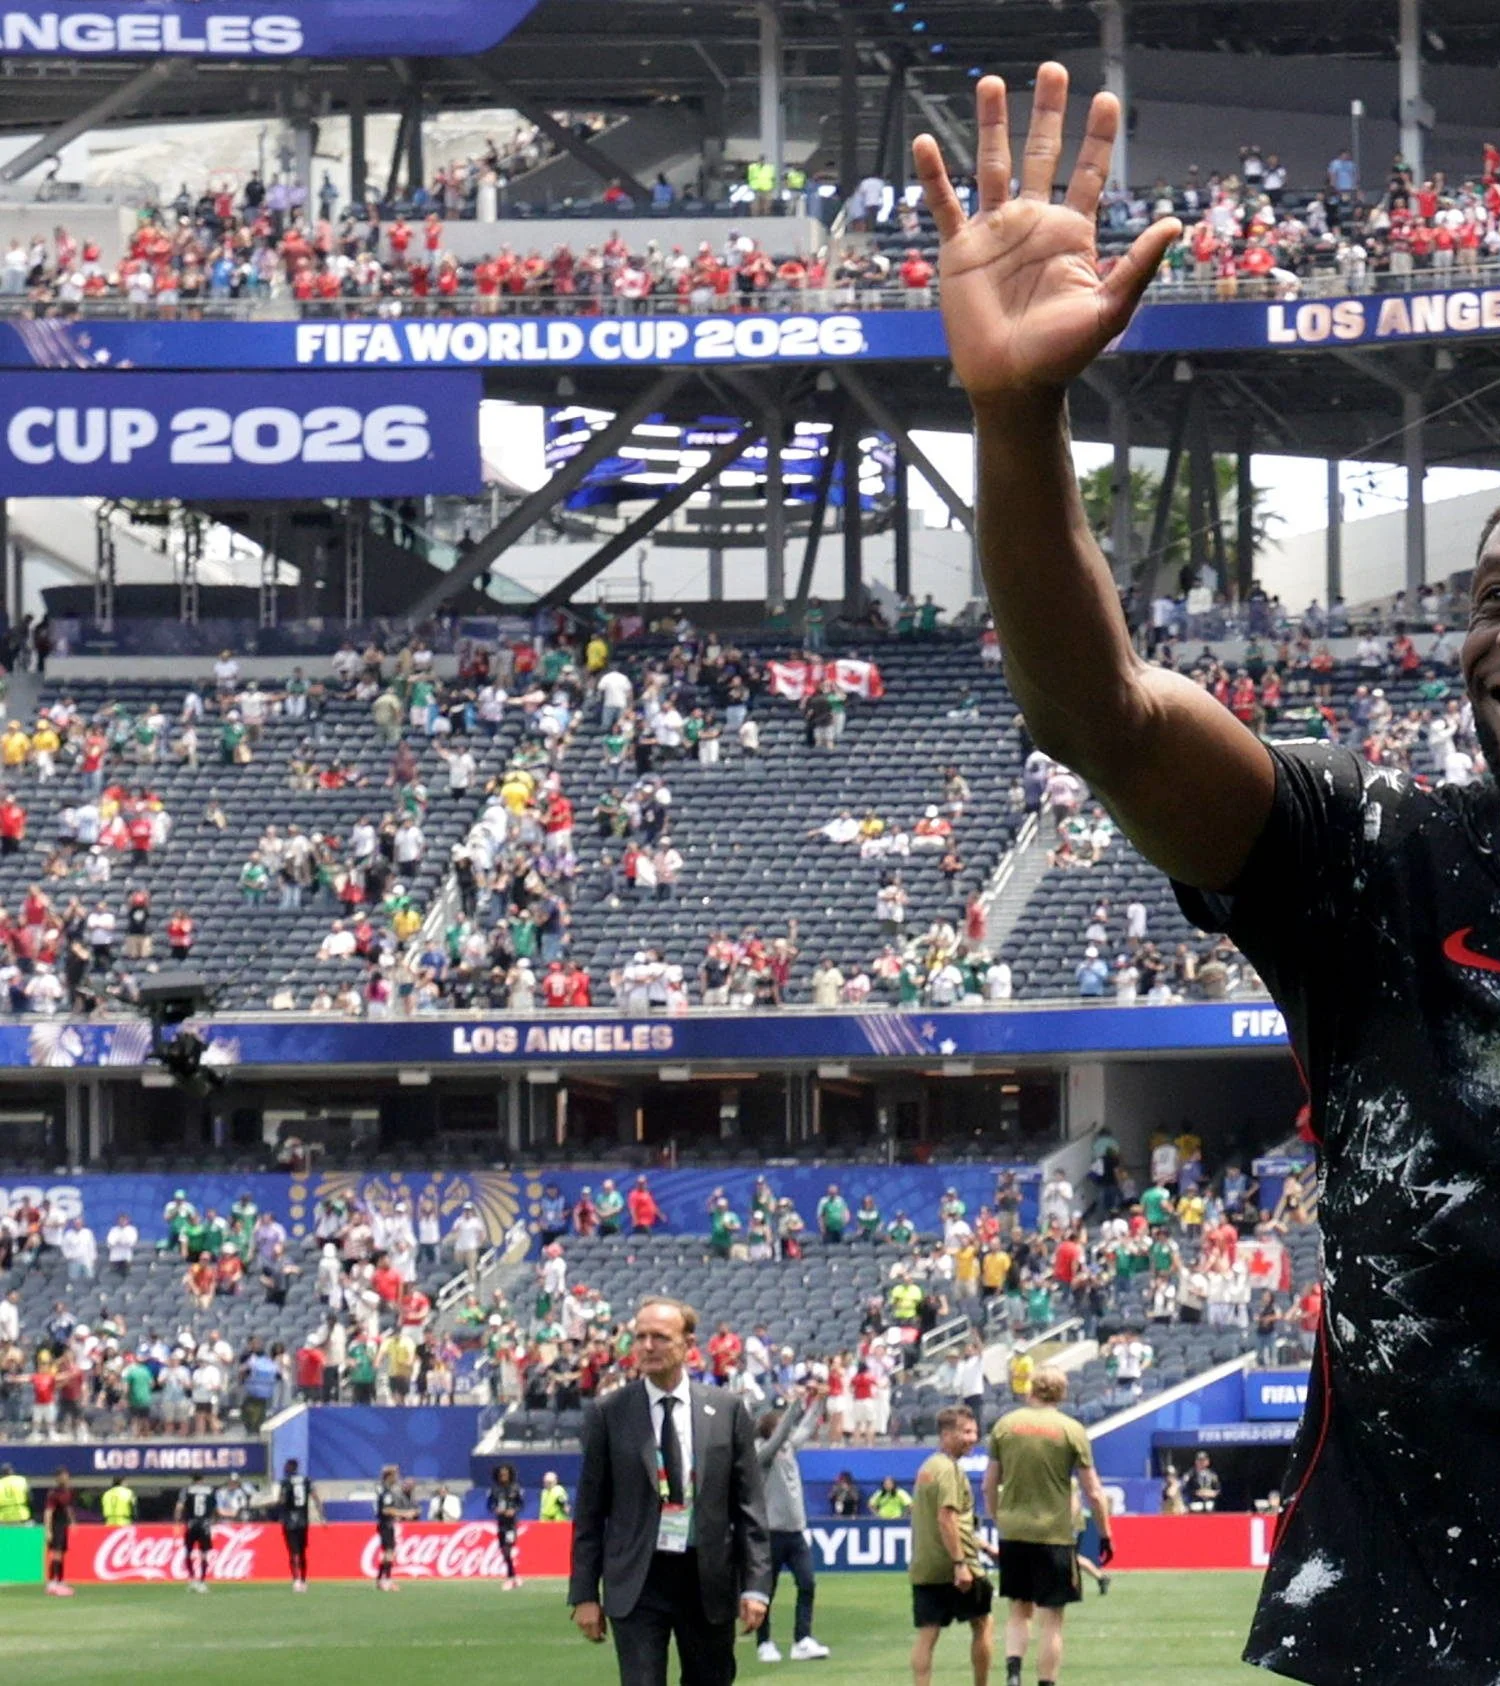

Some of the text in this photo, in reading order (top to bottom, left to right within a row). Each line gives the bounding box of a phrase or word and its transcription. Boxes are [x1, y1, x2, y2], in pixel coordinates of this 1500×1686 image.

[0, 12, 304, 53] NGELES
[296, 315, 863, 363] FIFA WORLD CUP 2026
[1267, 301, 1366, 343] LOS
[7, 404, 431, 464] CUP 2026
[453, 1024, 674, 1053] LOS ANGELES
[94, 1449, 247, 1469] LOS ANGELES
